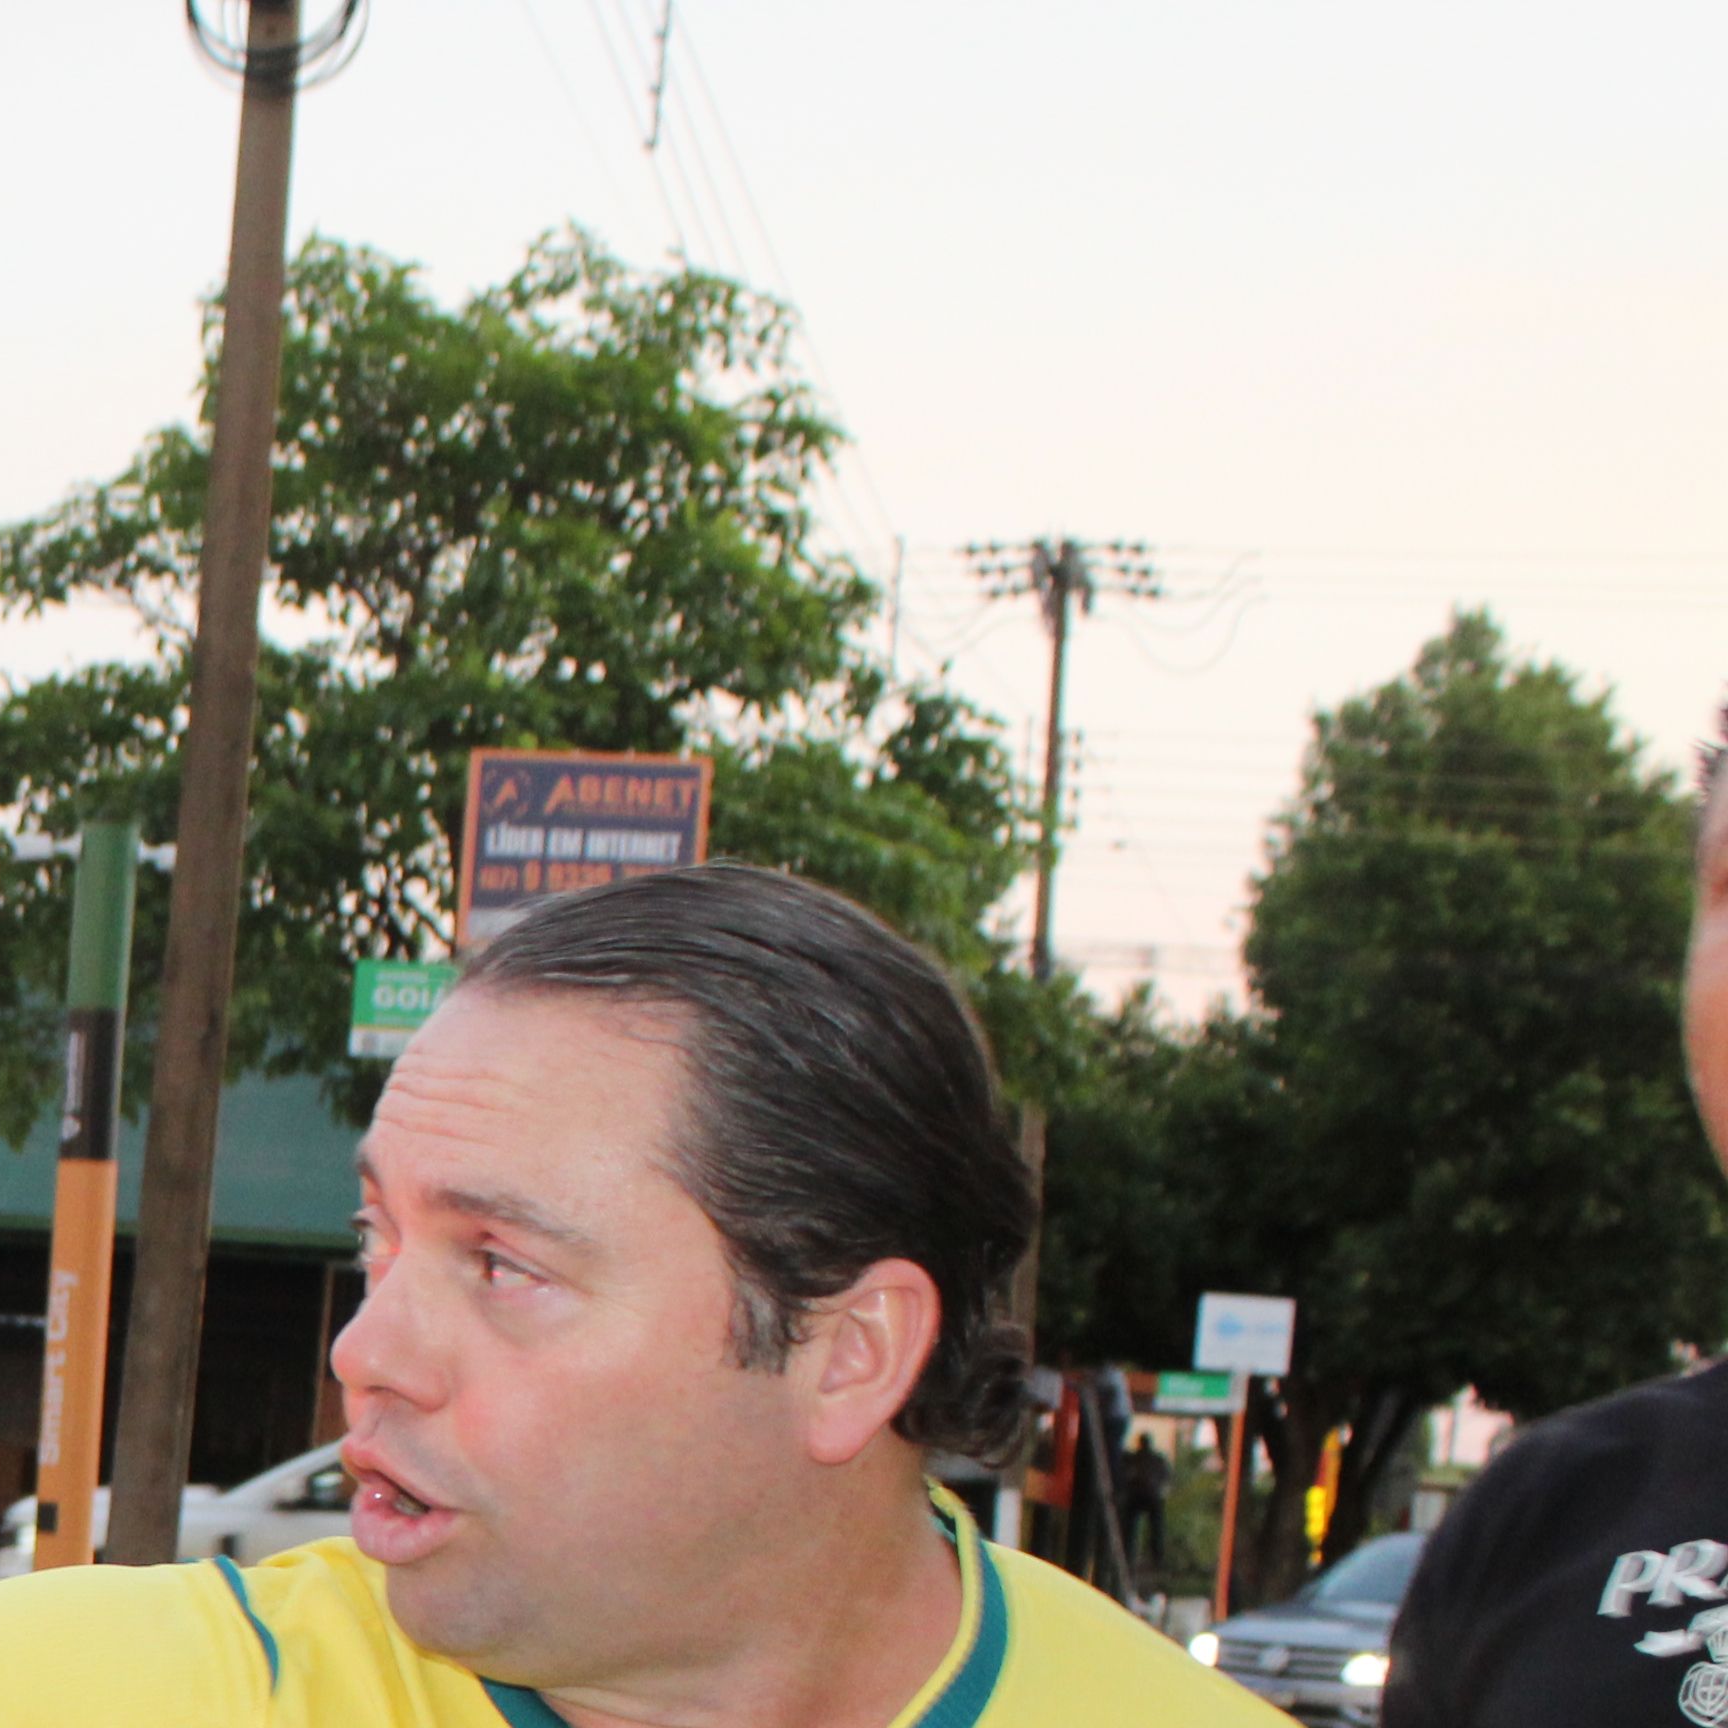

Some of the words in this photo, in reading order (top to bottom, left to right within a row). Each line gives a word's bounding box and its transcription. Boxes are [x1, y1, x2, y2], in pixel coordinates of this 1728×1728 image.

[546, 826, 584, 860] EM
[584, 828, 682, 864] INTERNET
[45, 1268, 81, 1342] City
[37, 1349, 67, 1467] Smart
[1597, 1538, 1728, 1618] PR
